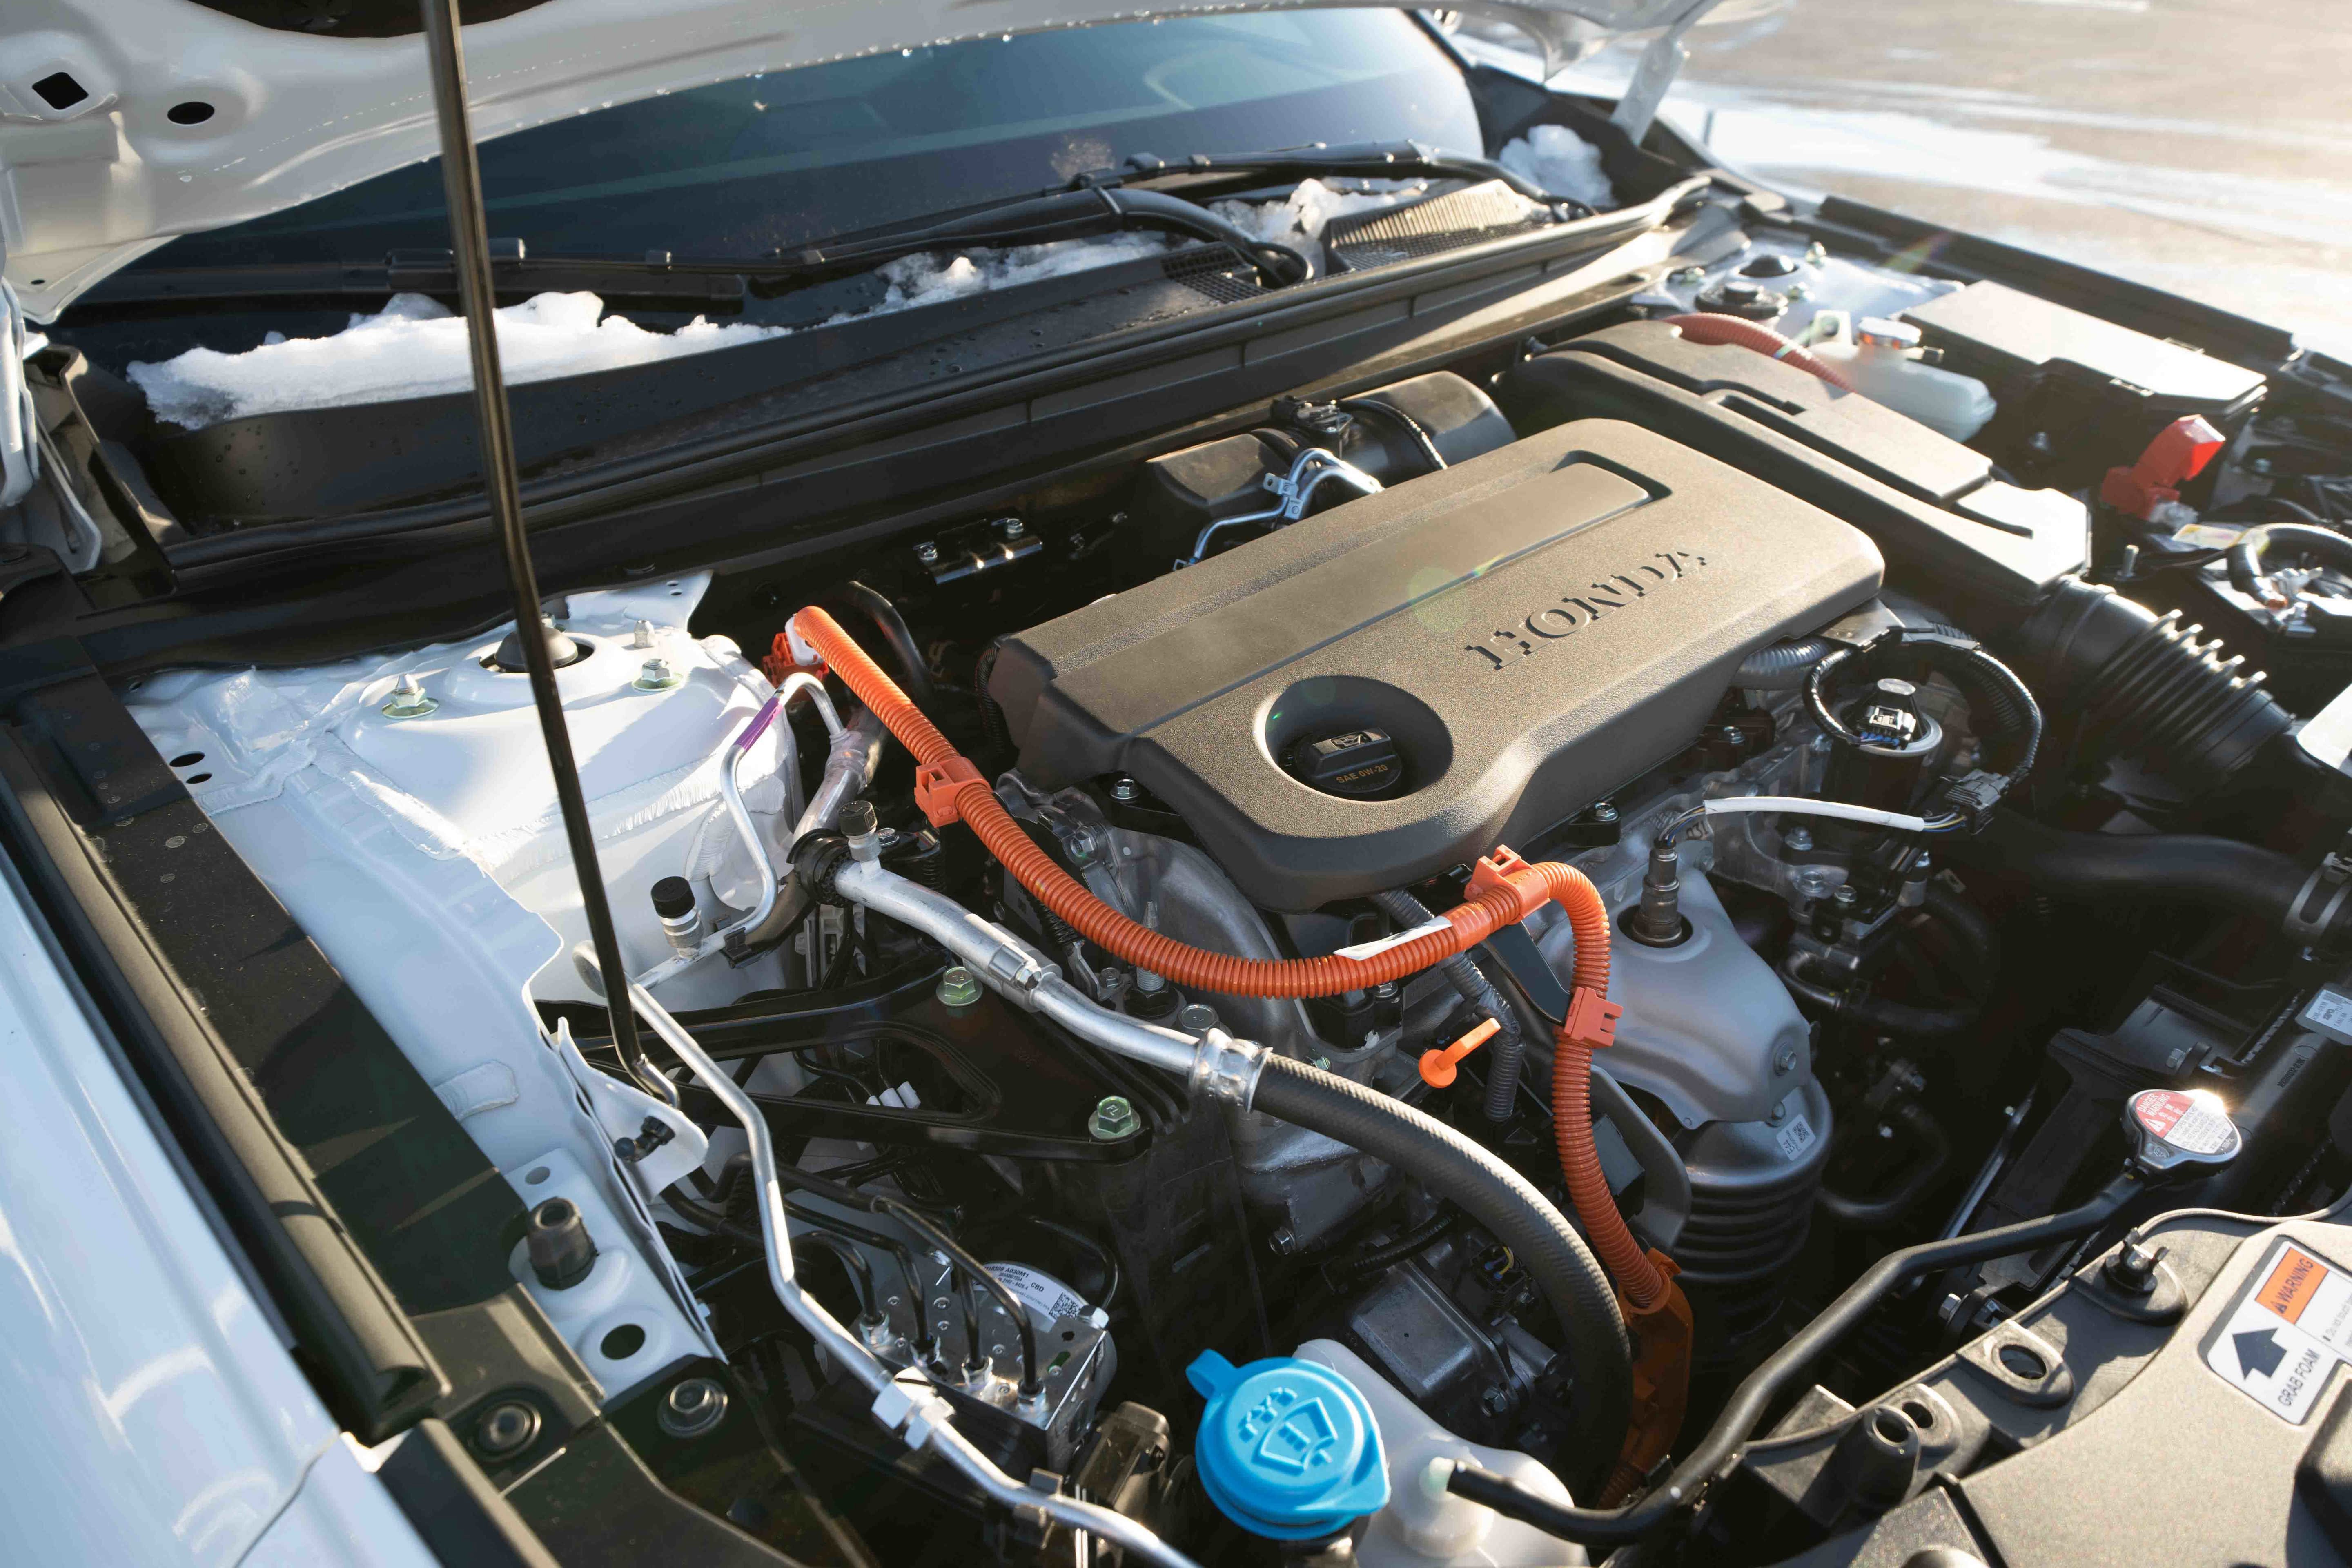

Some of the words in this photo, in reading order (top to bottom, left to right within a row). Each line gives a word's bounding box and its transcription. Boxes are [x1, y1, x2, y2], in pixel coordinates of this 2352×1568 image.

[1464, 549, 1711, 671] HONDA
[1336, 772, 1359, 784] SAE
[1359, 764, 1388, 778] 0W-20
[2137, 1093, 2159, 1113] DANGER
[2278, 1257, 2314, 1302] WARNING
[2278, 1375, 2303, 1407] GRAB
[2295, 1348, 2321, 1379] FOAM
